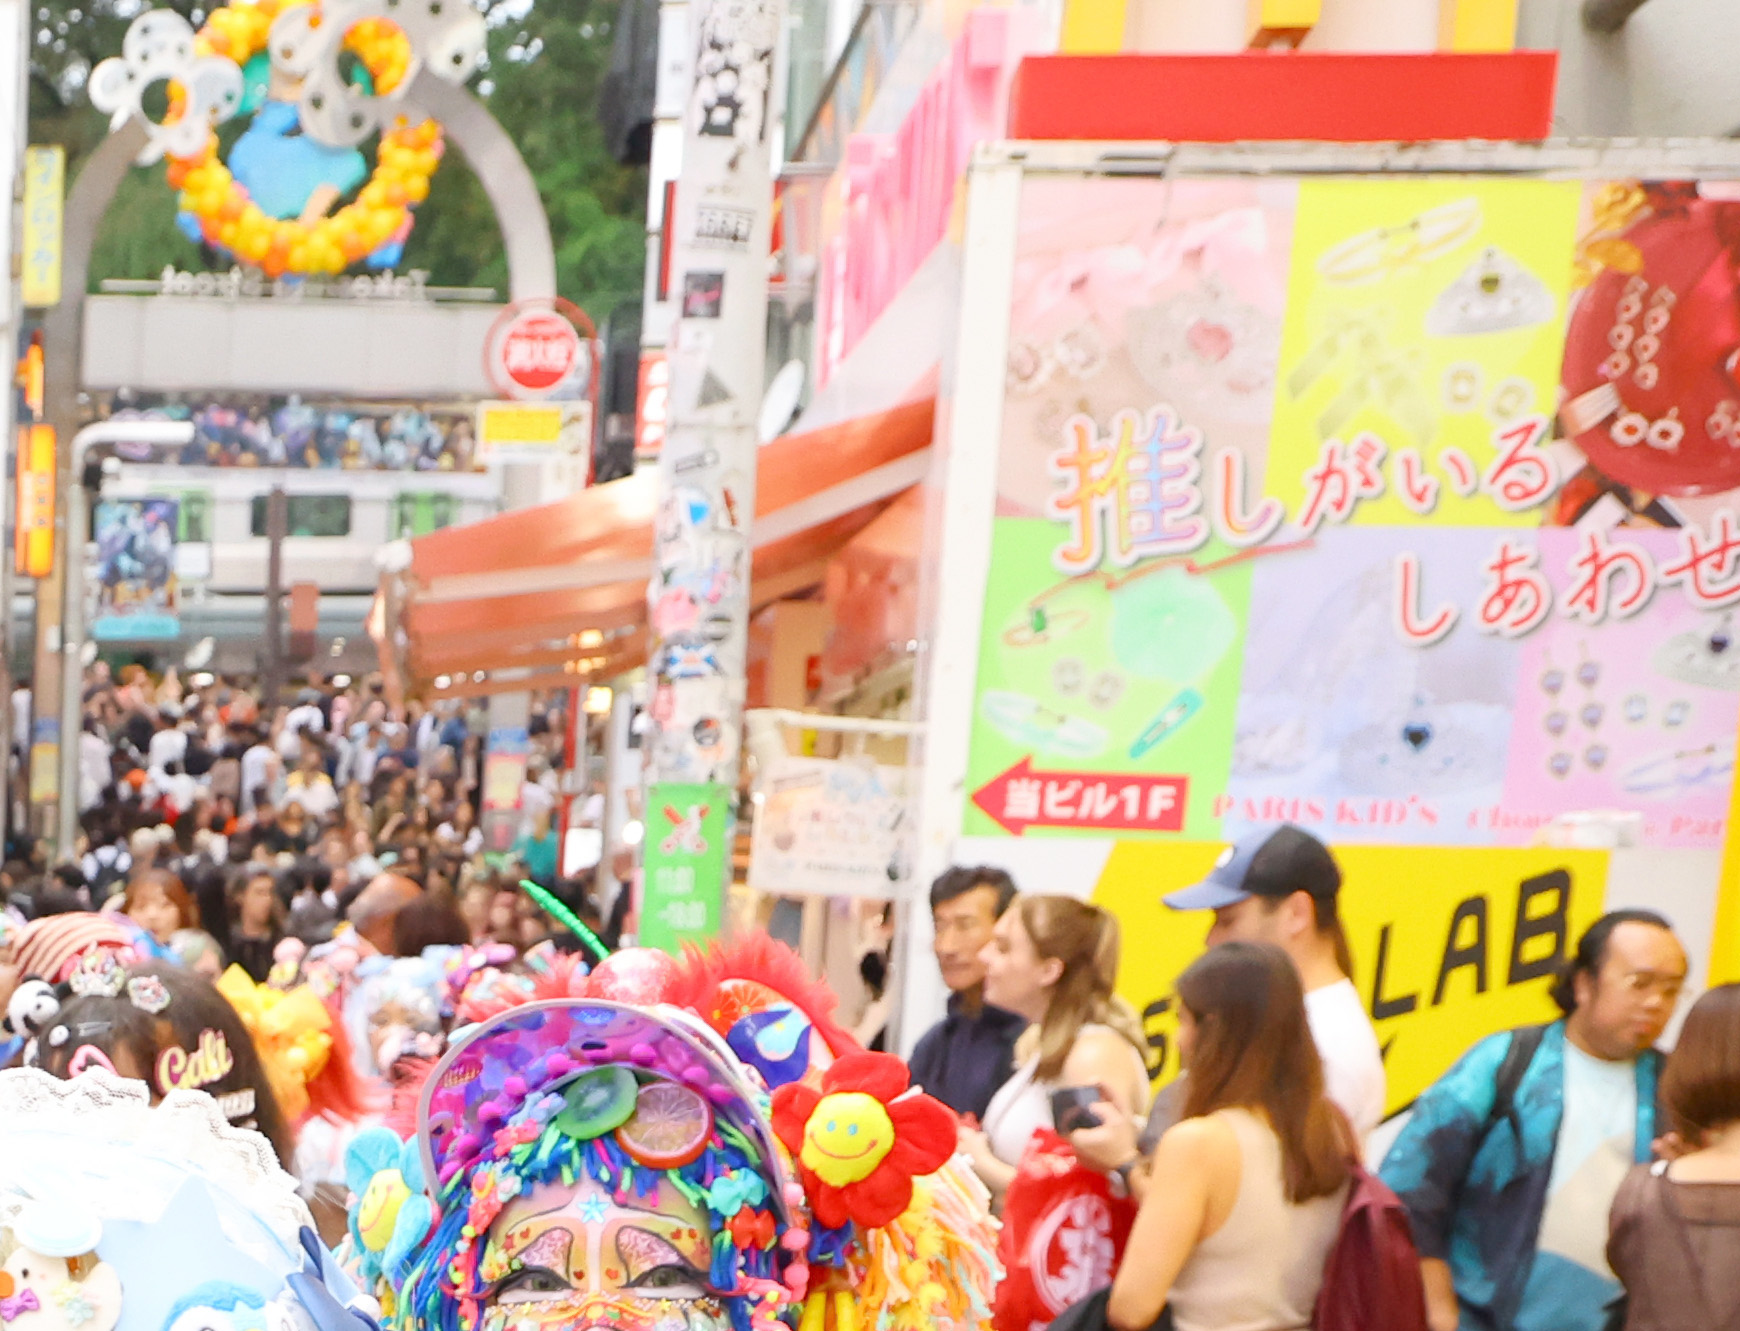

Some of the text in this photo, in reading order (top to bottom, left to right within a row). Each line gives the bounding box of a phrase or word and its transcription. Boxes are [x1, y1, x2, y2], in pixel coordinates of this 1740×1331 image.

[1052, 413, 1548, 567] 推しがいる
[1397, 517, 1740, 638] しあわせ
[1003, 777, 1177, 821] 当ビル1F
[1212, 793, 1326, 825] PARIS
[1370, 867, 1572, 1020] LAB
